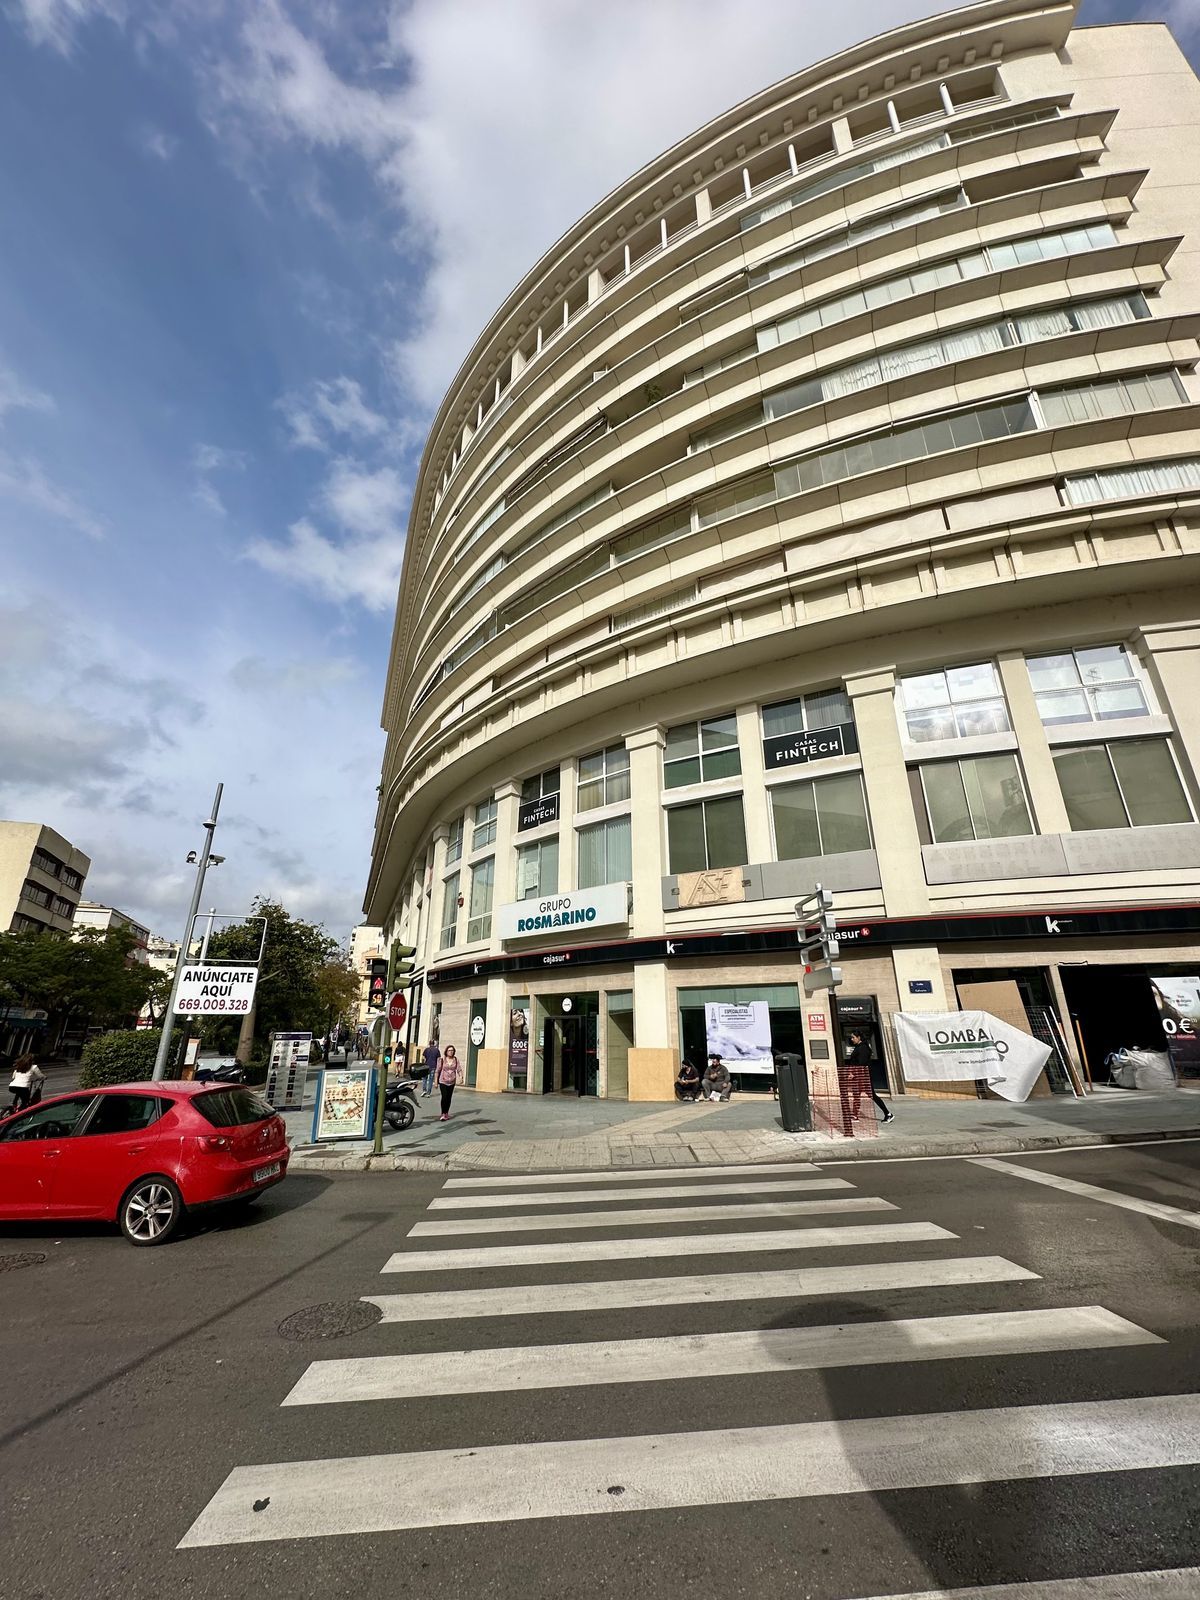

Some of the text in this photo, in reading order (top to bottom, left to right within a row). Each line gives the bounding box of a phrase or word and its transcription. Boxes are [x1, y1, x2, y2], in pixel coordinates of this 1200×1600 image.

[794, 738, 817, 748] CASAS
[776, 740, 839, 761] FINTECH
[523, 807, 555, 824] FINTECH
[539, 898, 571, 913] GRUPO
[517, 907, 597, 932] ROSMARINO
[543, 954, 566, 965] cajasur
[183, 968, 254, 983] ANÚNCIATE
[200, 983, 234, 997] AQUÍ
[178, 999, 248, 1010] 669.009.328
[390, 1007, 406, 1017] STOP
[512, 1040, 524, 1049] 600
